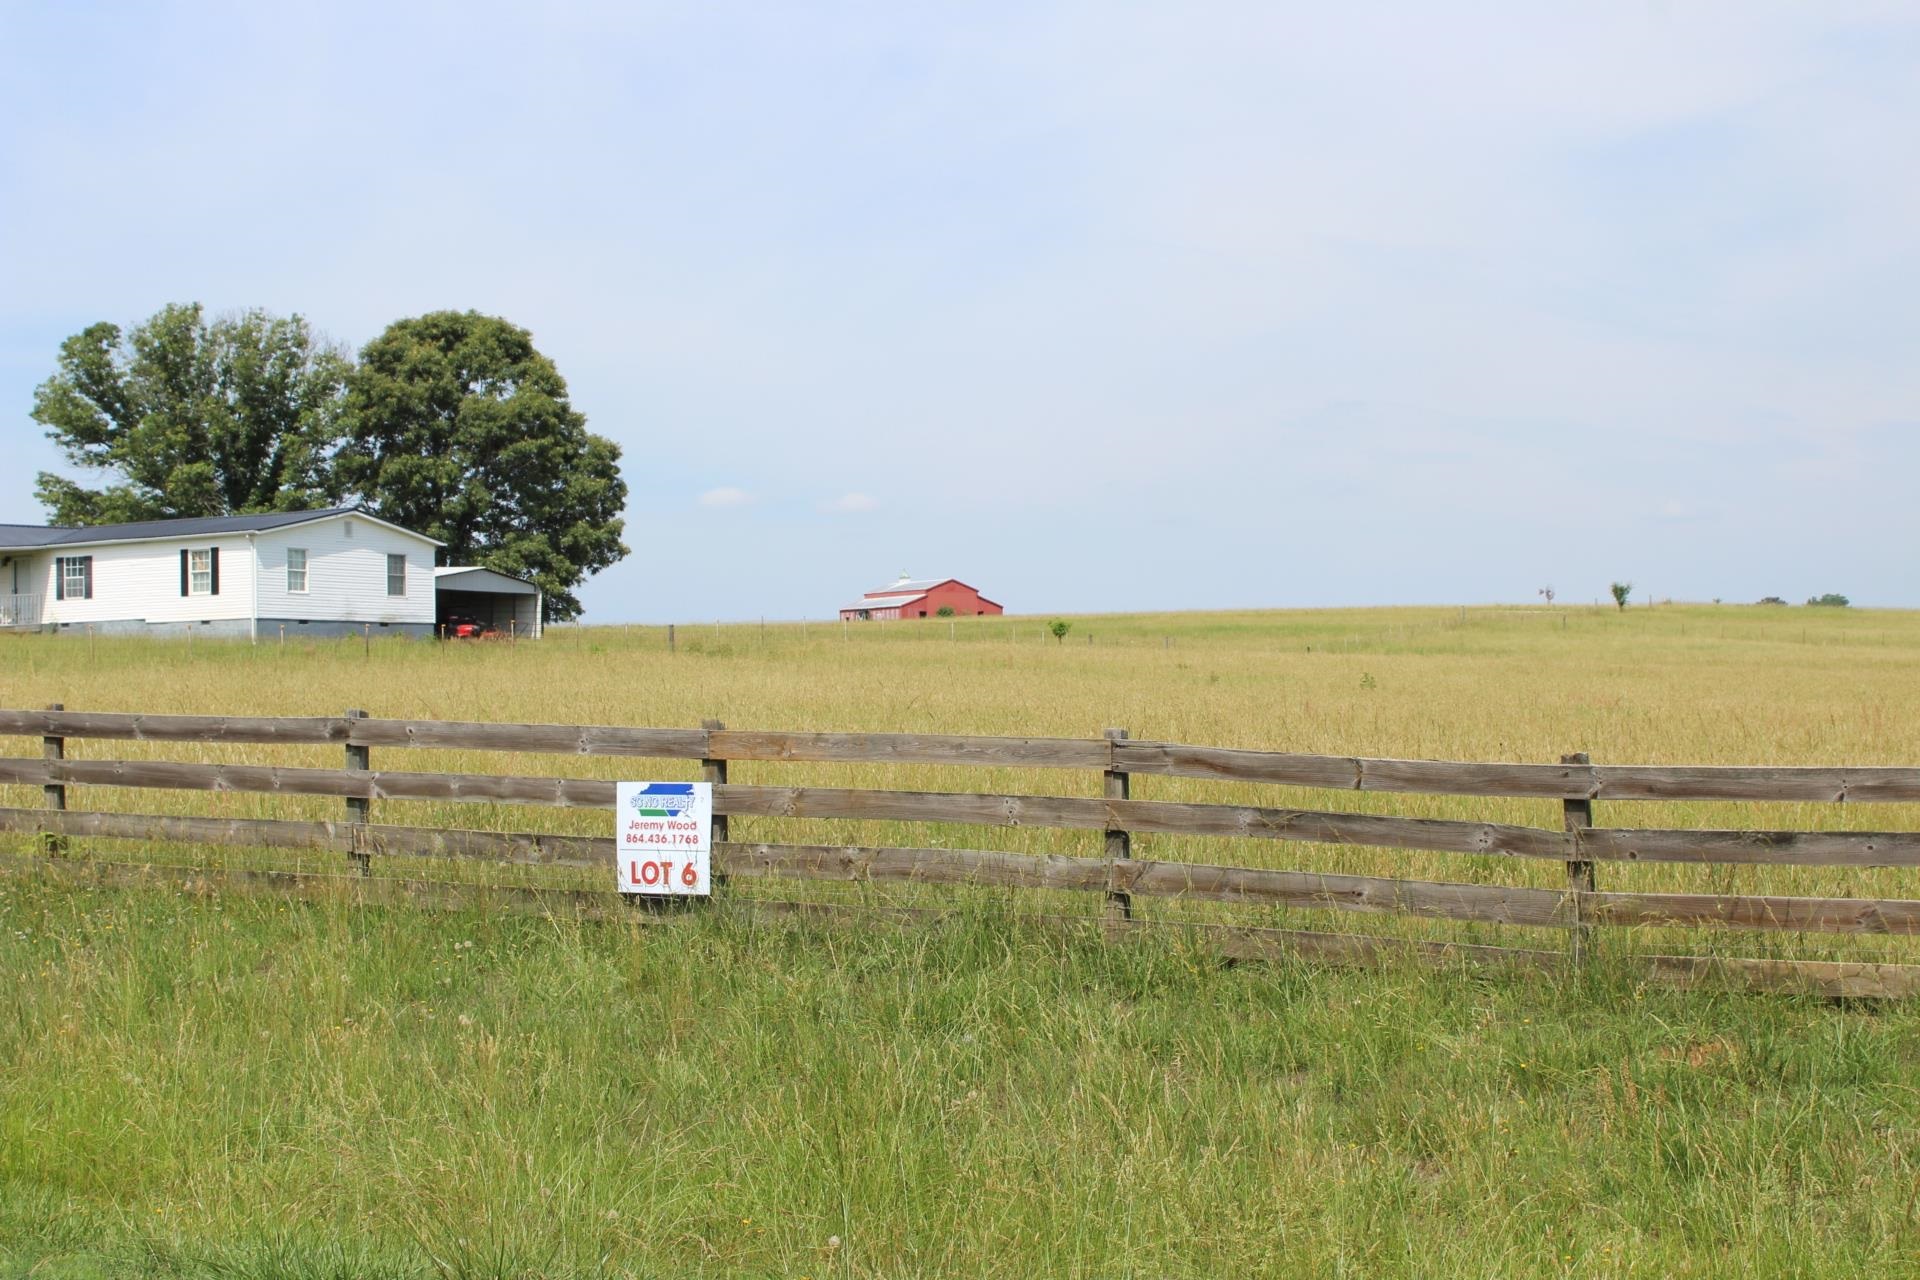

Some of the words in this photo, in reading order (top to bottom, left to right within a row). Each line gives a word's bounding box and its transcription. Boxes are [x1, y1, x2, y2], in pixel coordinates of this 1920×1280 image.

[629, 820, 664, 831] Jeremy
[667, 820, 697, 830] Wood
[626, 833, 699, 844] 864.436.1768
[631, 861, 673, 885] LOT
[681, 862, 698, 886] 6
